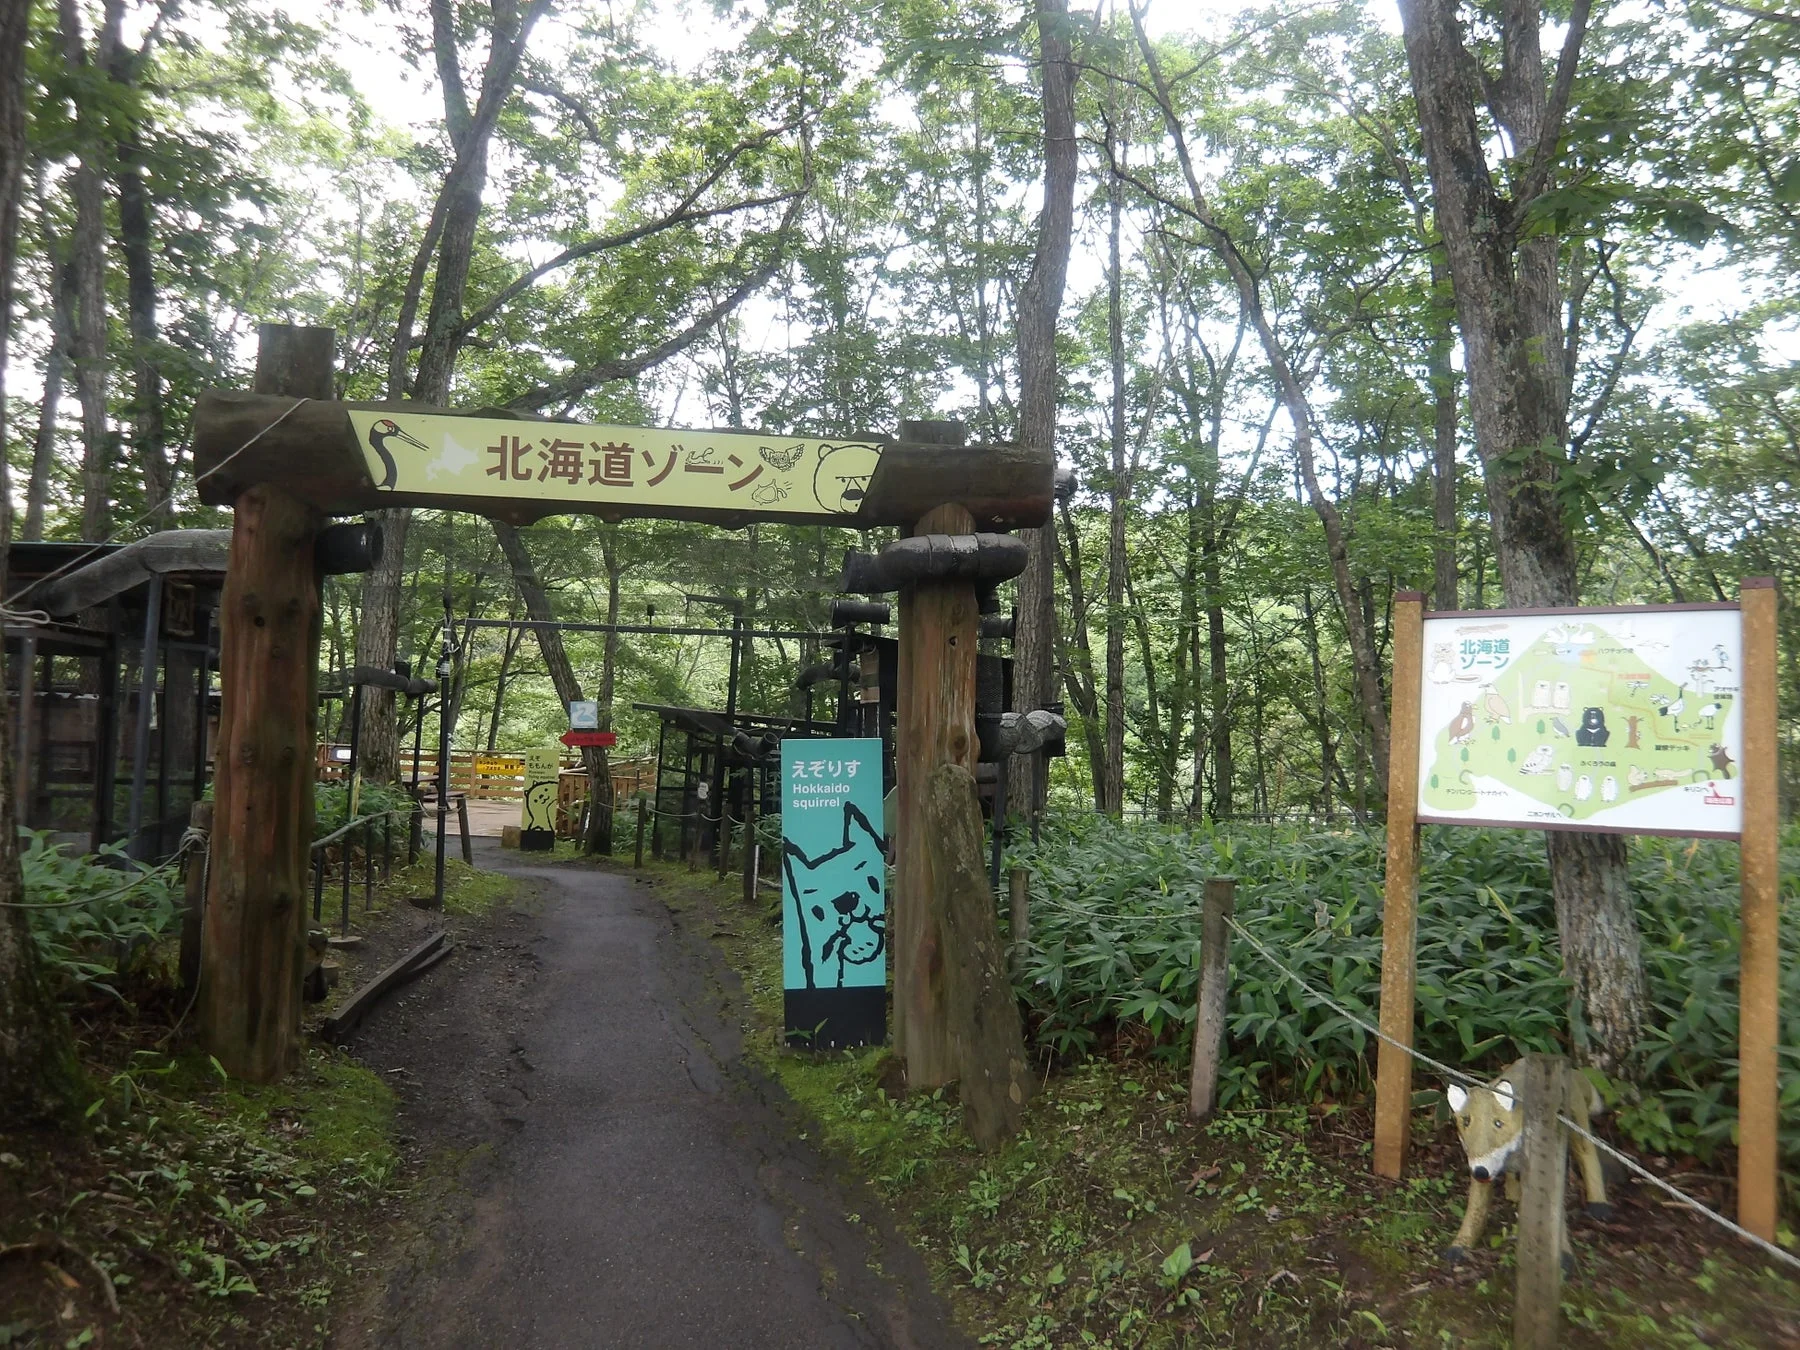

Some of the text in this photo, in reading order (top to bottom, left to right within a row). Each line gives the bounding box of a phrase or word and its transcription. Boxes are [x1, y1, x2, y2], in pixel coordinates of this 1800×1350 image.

[485, 434, 765, 492] 北海道ゾーン
[1459, 638, 1511, 655] 北海道
[1460, 655, 1510, 670] ゾーン
[791, 759, 862, 779] えぞりす
[793, 783, 850, 794] Hokkaido
[792, 797, 840, 810] squirrel
